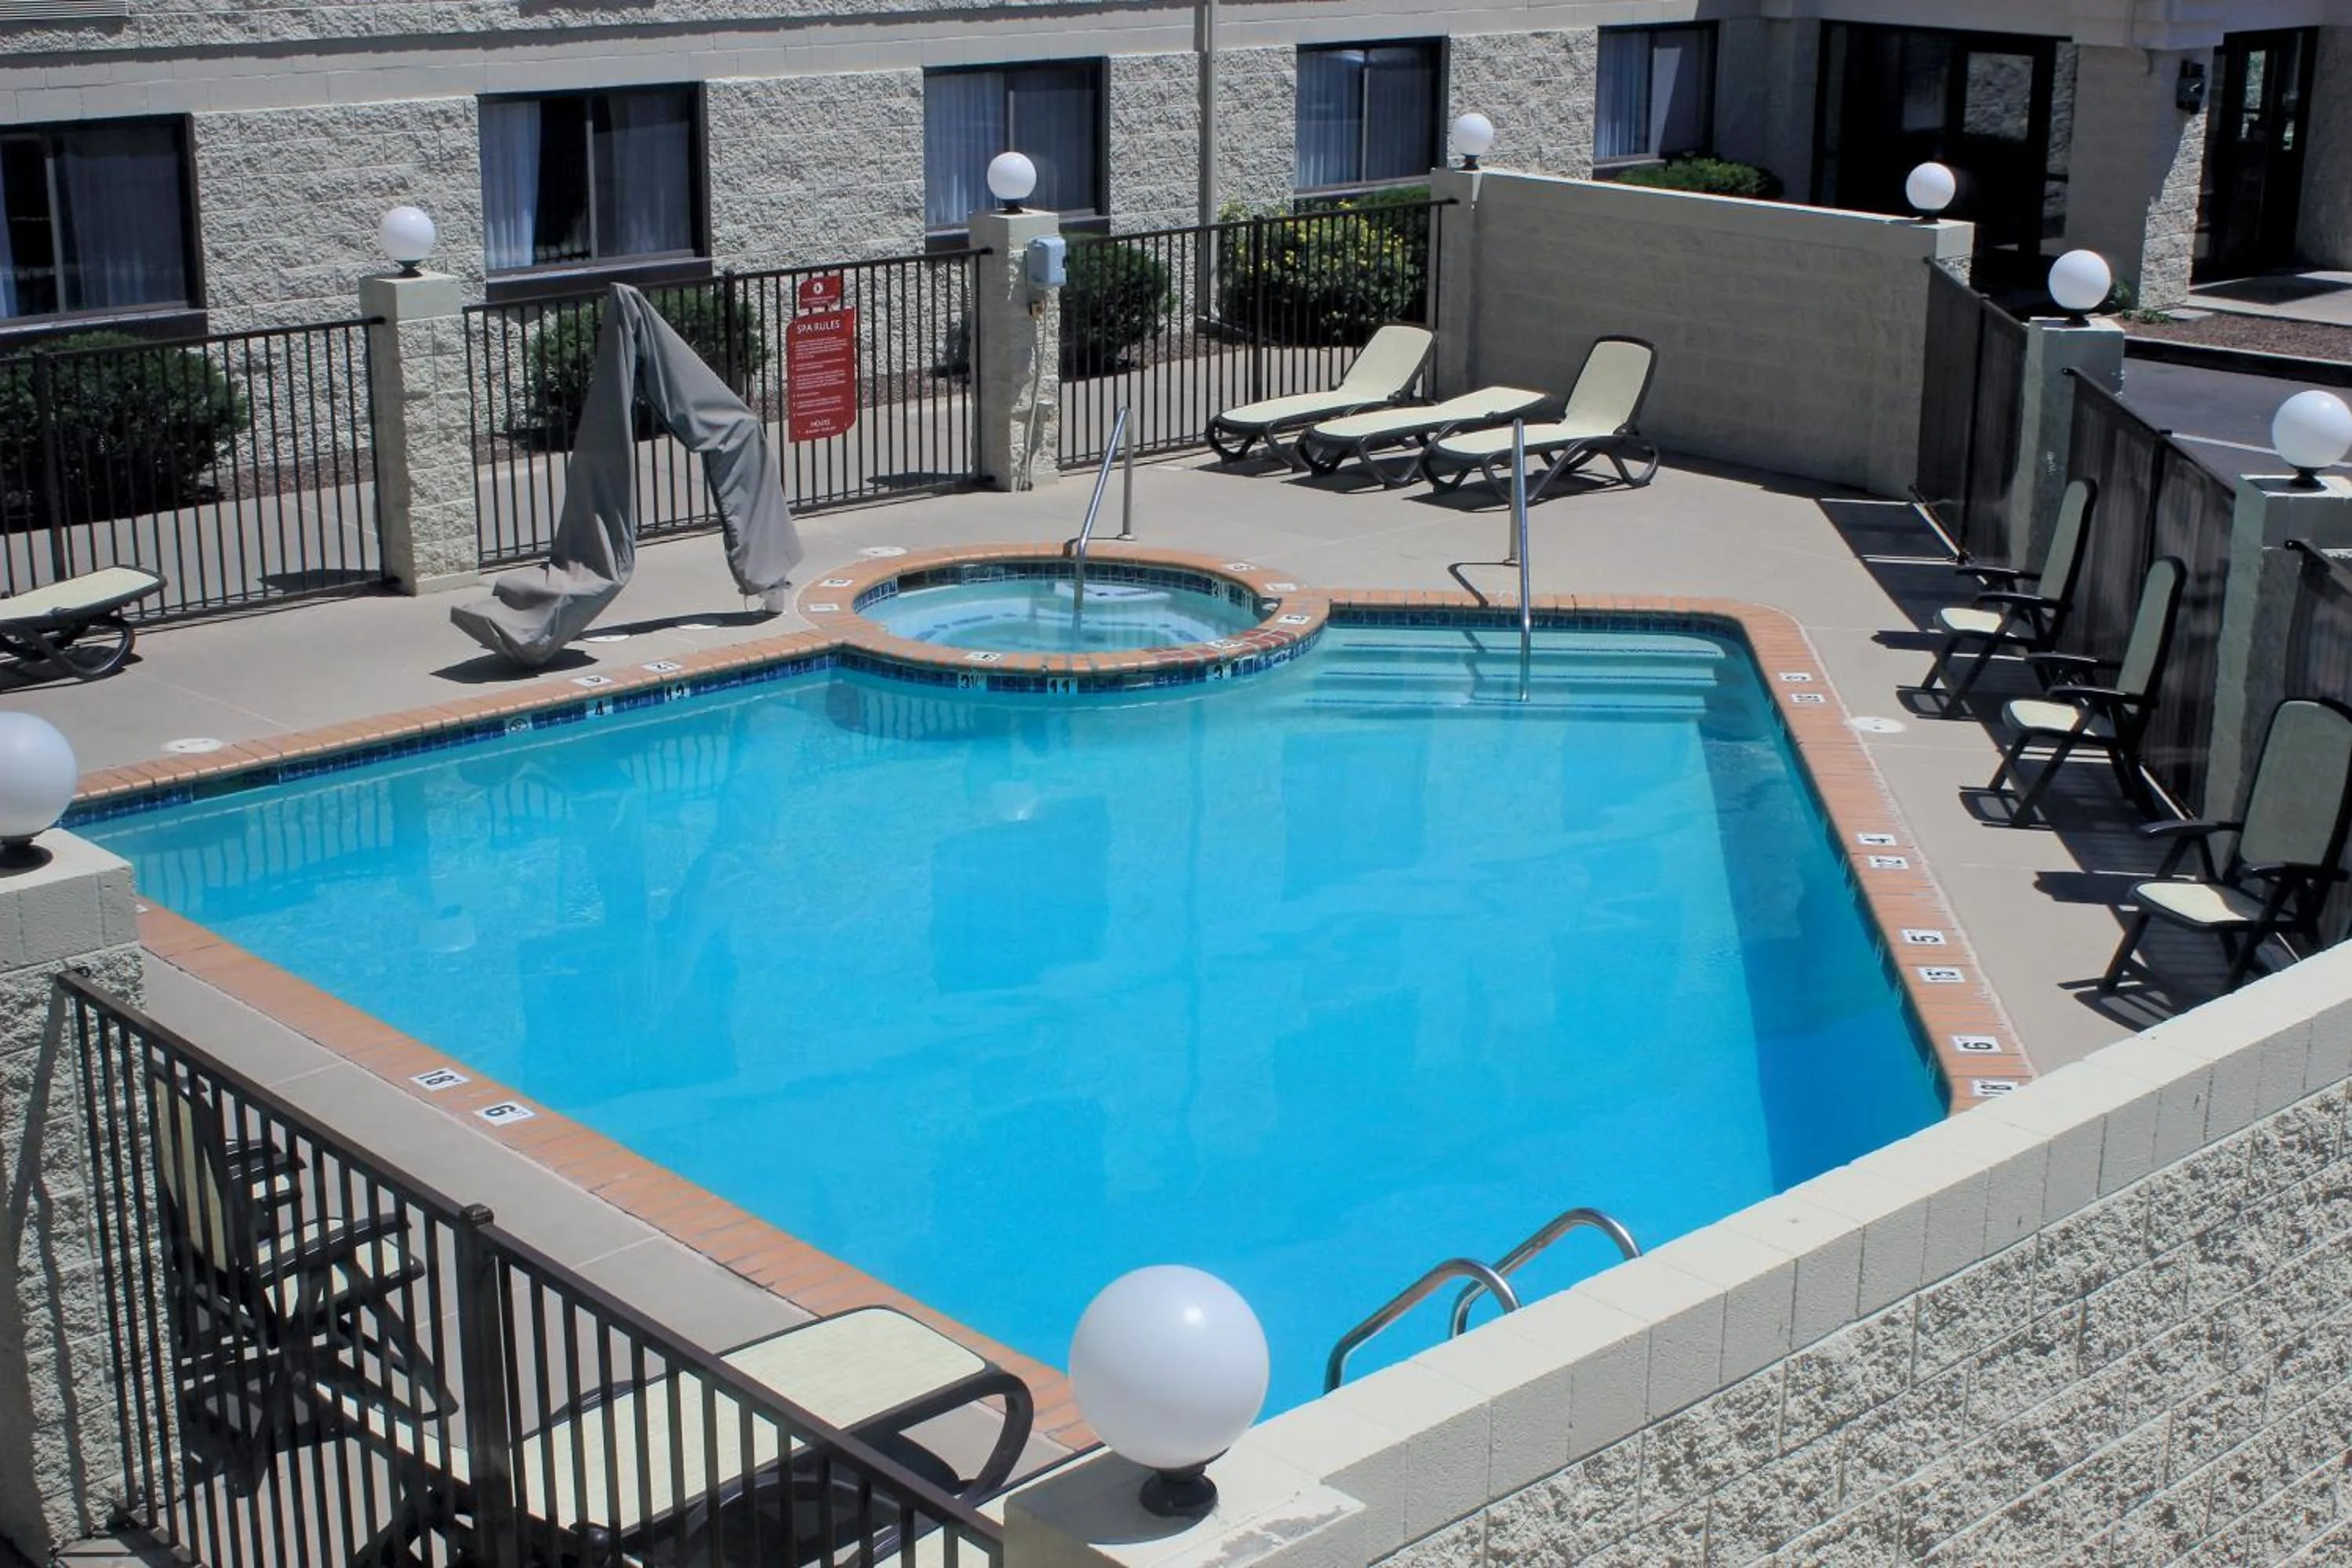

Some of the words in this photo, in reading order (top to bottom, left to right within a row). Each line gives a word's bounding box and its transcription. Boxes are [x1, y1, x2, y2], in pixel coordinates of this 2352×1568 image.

[797, 323, 813, 334] SPA
[814, 319, 840, 332] RULES
[1911, 934, 1939, 943] 5
[1962, 1041, 1994, 1051] 6
[418, 1069, 454, 1086] 18
[485, 1105, 517, 1116] 6
